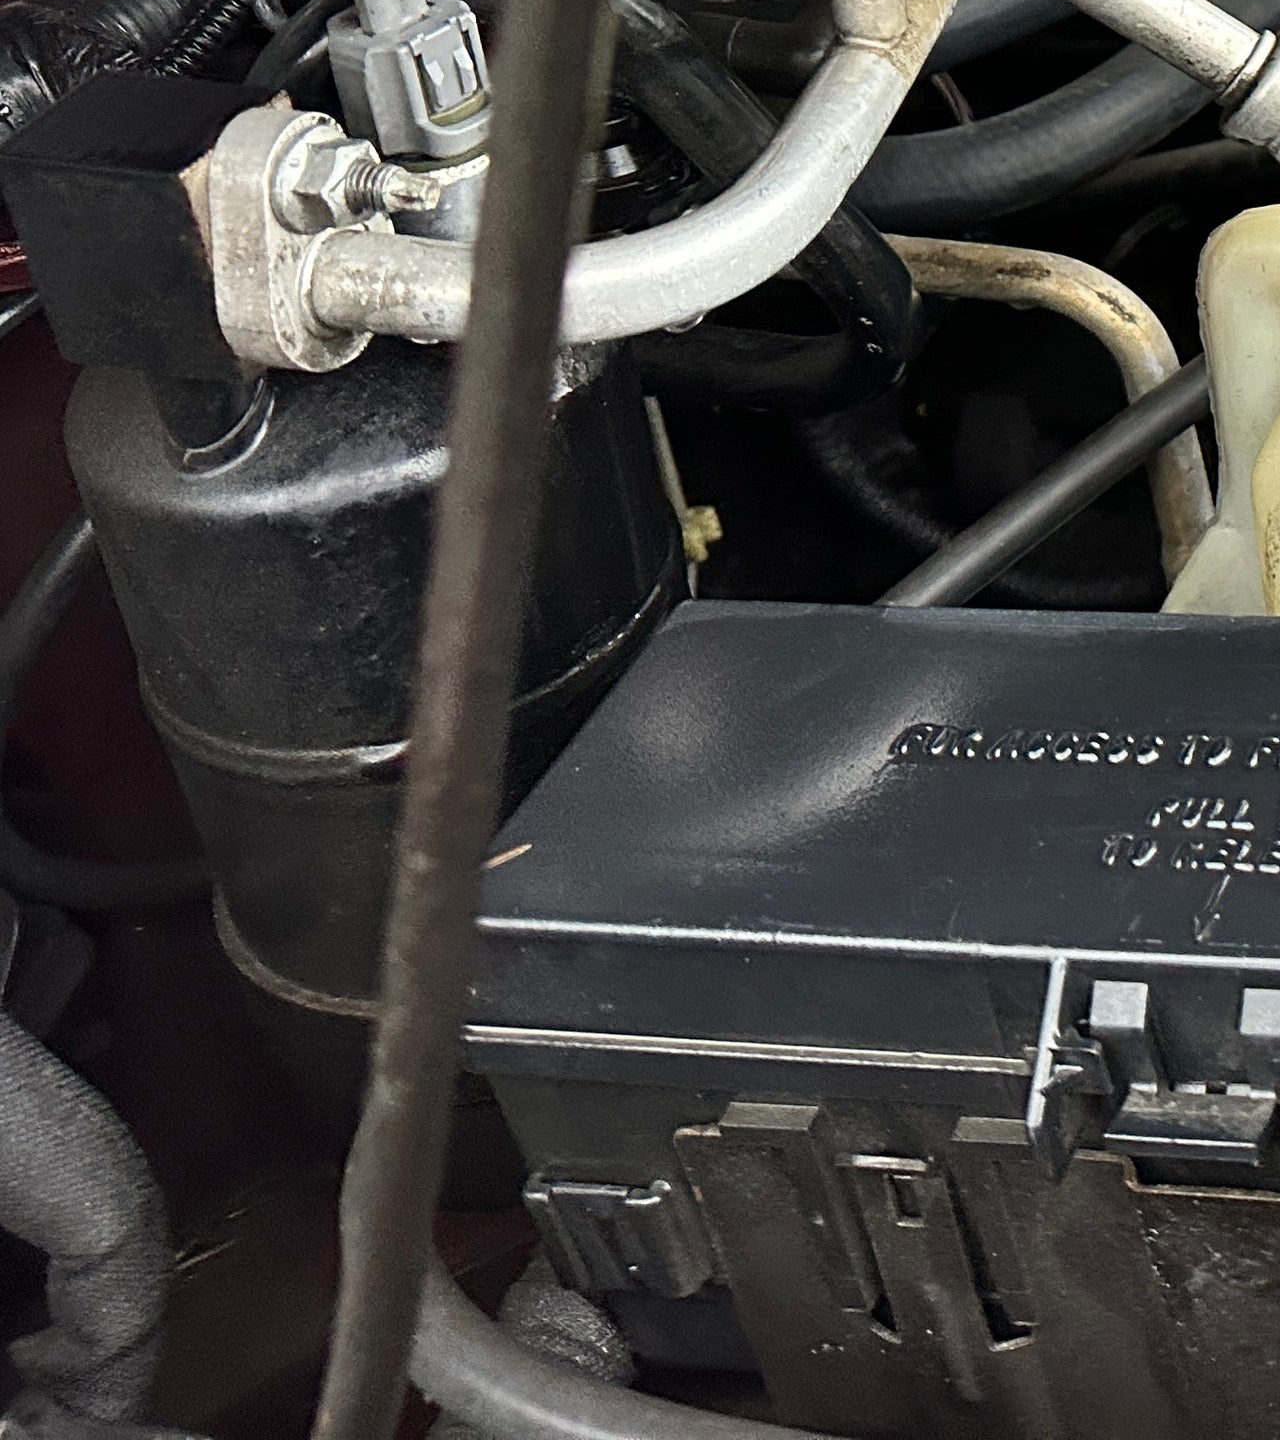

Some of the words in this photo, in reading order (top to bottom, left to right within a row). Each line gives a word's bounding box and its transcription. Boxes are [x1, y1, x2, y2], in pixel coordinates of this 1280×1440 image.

[987, 729, 1164, 765] ACCESS
[1181, 733, 1232, 766] TO
[1147, 797, 1255, 832] PULL
[1102, 833, 1158, 868] TO
